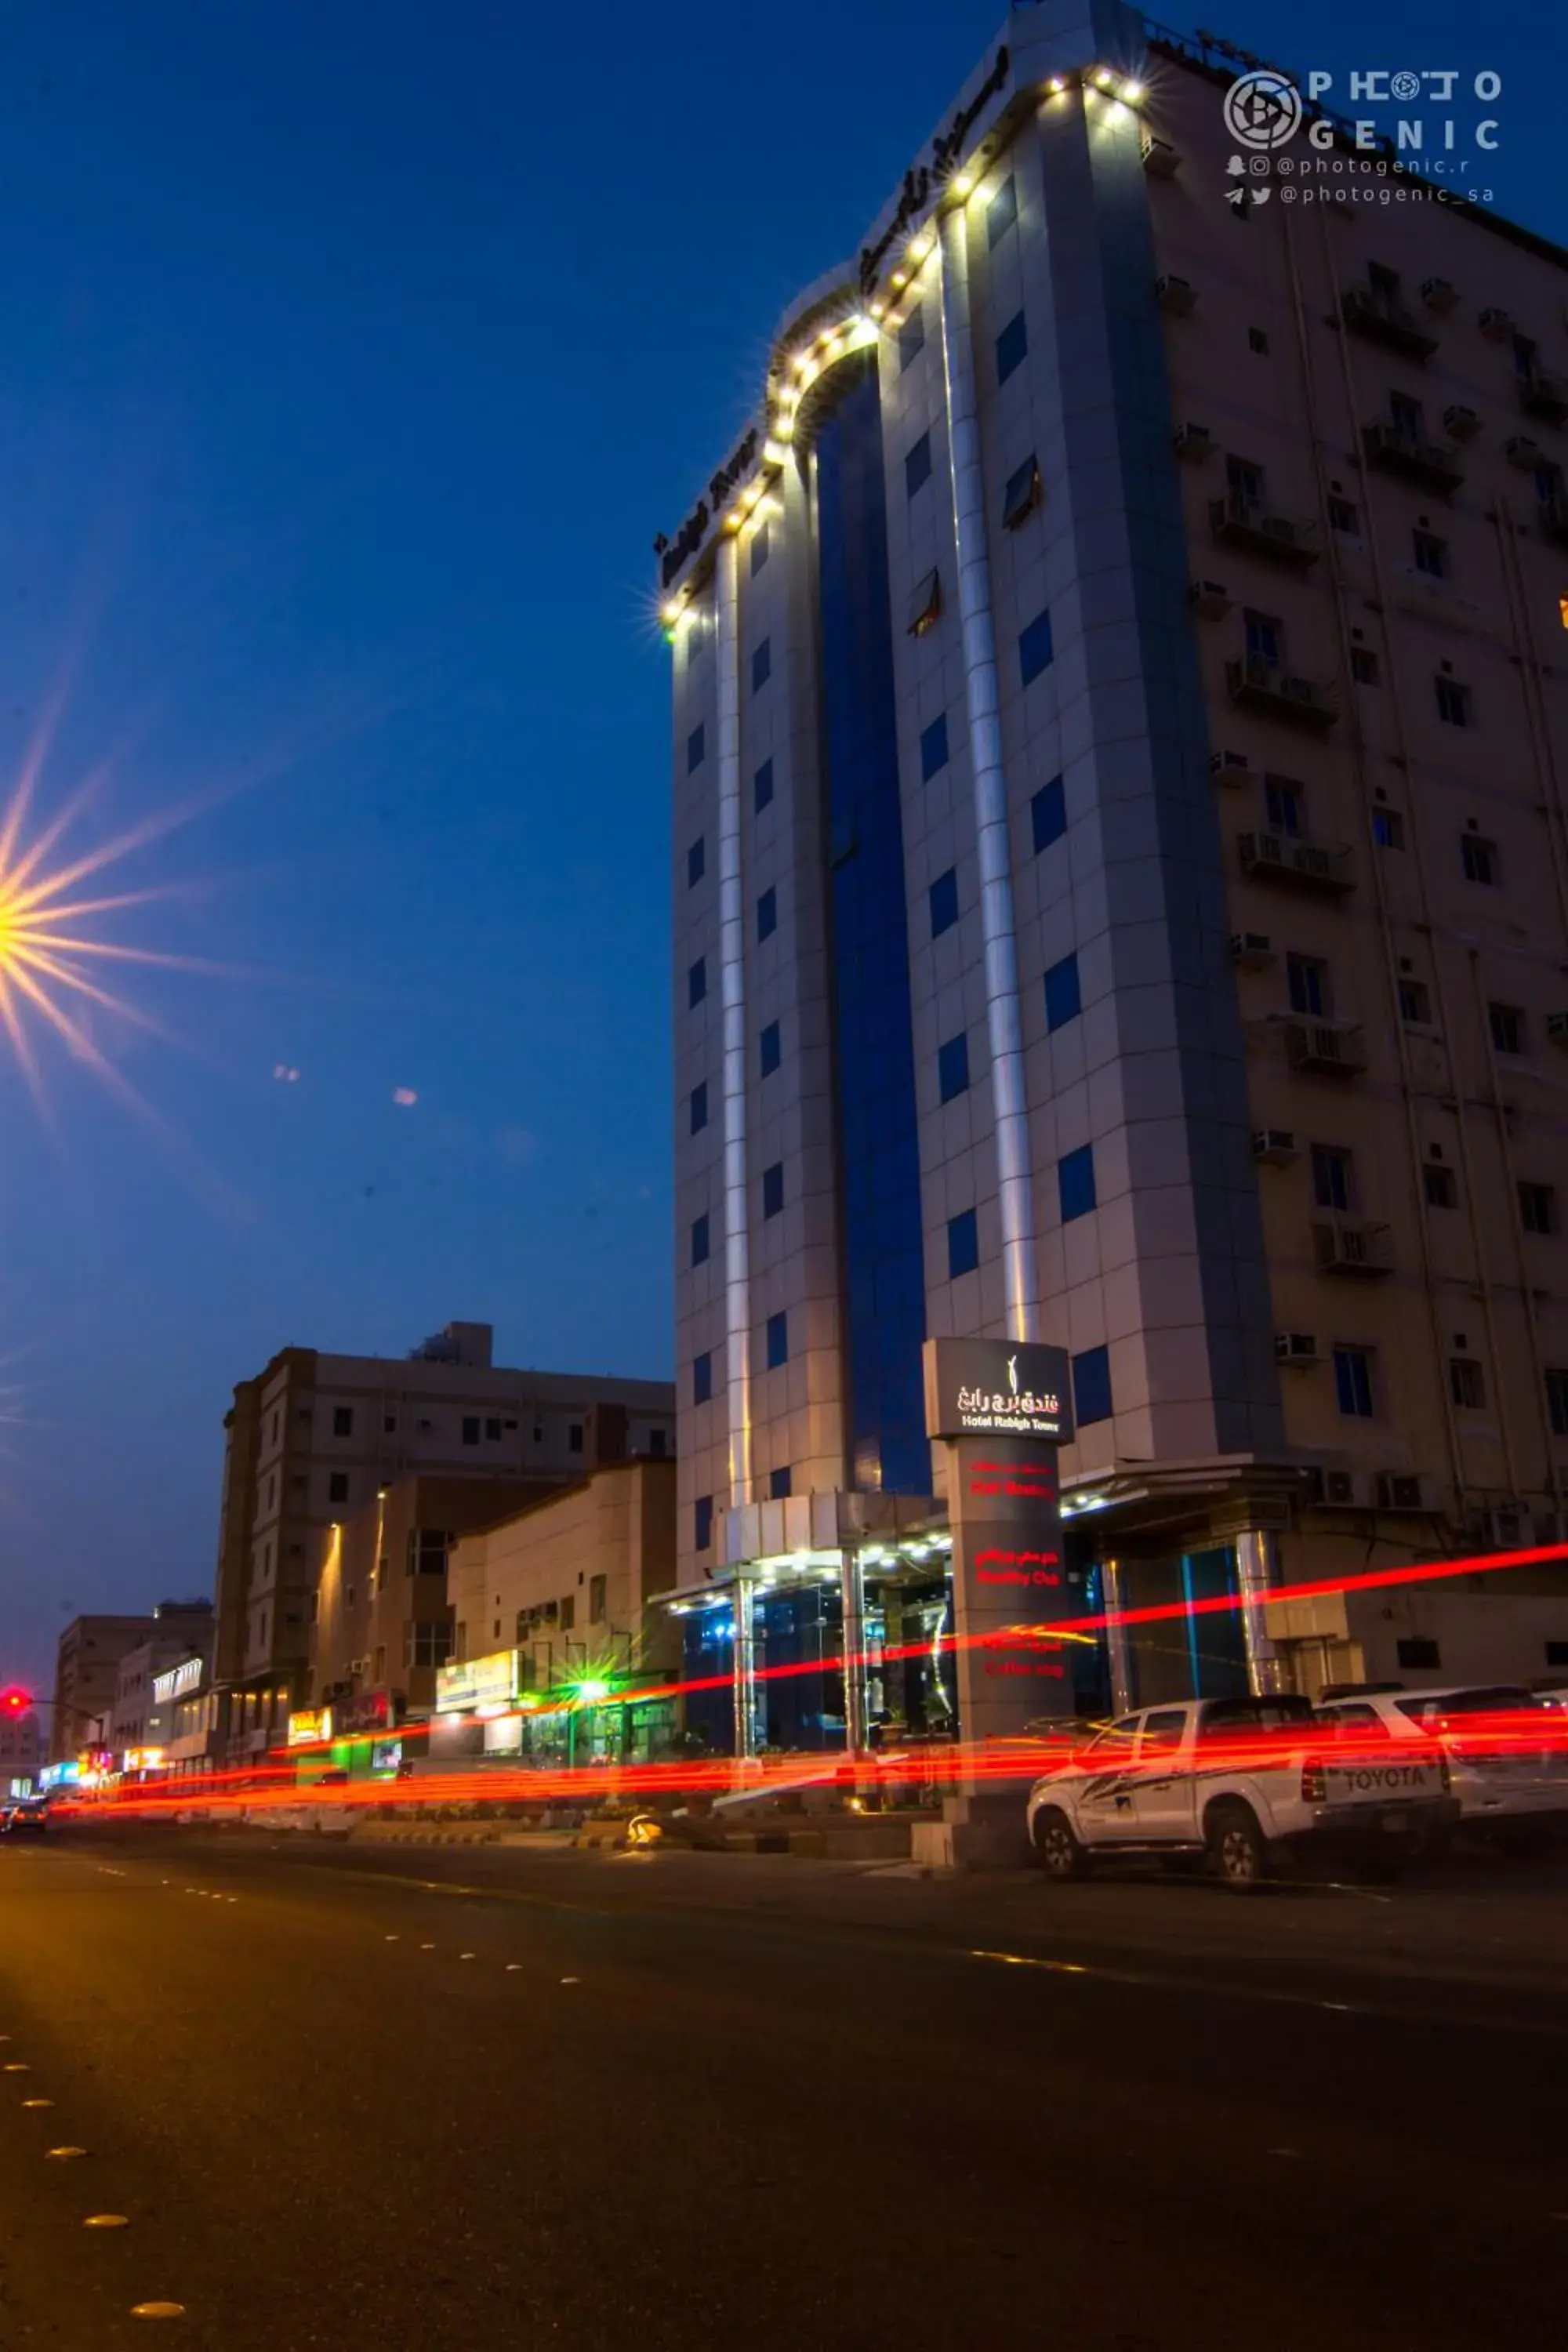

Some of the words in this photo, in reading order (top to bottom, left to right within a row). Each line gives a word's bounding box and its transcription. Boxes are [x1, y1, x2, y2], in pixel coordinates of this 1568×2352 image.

[957, 1386, 989, 1412] رابغ
[992, 1393, 1020, 1414] برج
[1022, 1392, 1060, 1414] فندق
[962, 1415, 992, 1427] Hotel
[994, 1416, 1030, 1431] Rabigh
[1344, 1766, 1426, 1792] TOYOTA
